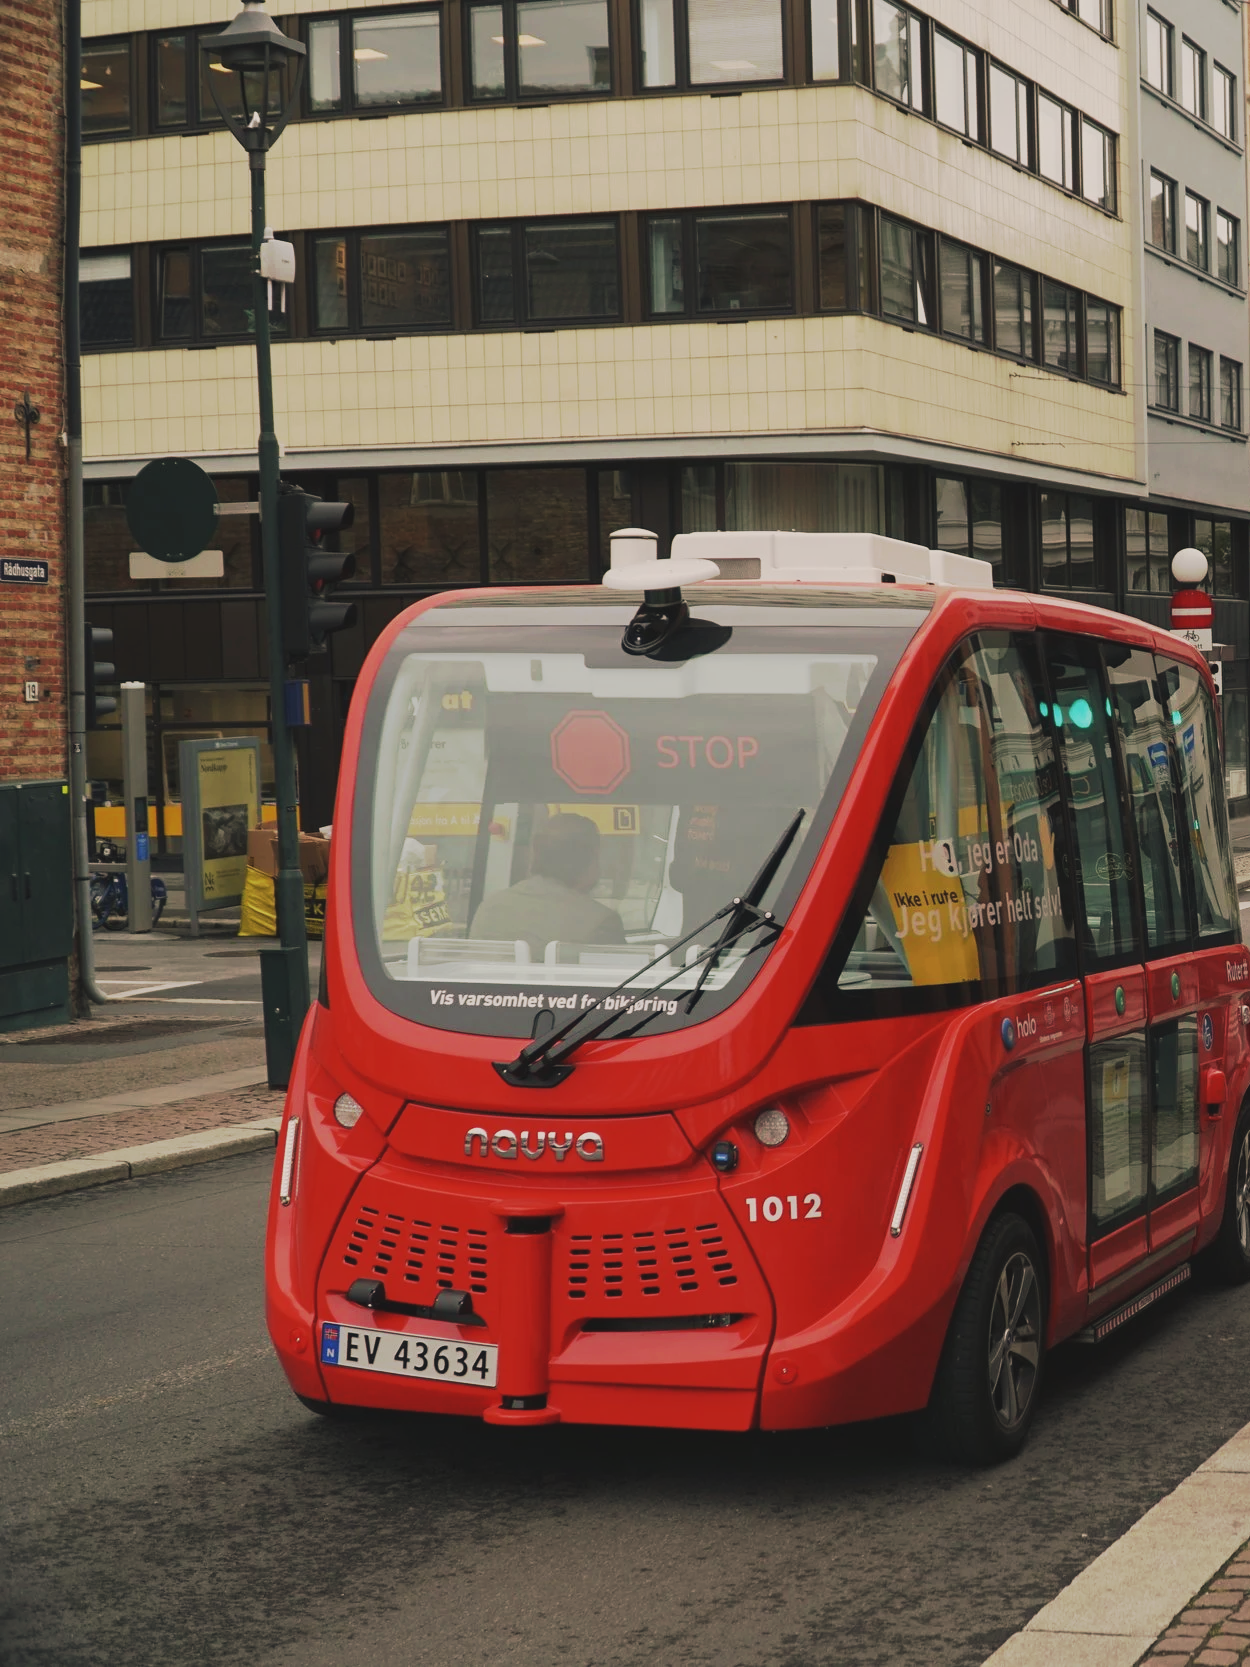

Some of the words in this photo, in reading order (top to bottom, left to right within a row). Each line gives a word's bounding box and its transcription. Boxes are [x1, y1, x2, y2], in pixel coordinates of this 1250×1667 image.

[3, 562, 45, 580] Rådhusgata
[27, 684, 36, 698] 19
[656, 735, 760, 769] STOP
[966, 836, 993, 874] jeg
[995, 839, 1010, 865] er
[1013, 832, 1038, 863] Oda
[894, 893, 922, 908] Ikke
[930, 890, 959, 905] rute
[895, 904, 942, 942] Jeg
[949, 900, 1004, 938] kjører
[1005, 891, 1033, 924] helt
[1034, 886, 1064, 920] selv!
[430, 989, 454, 1006] Vis
[458, 992, 544, 1009] varsomhet
[548, 994, 577, 1009] ved
[1016, 1013, 1037, 1039] holo
[745, 1193, 822, 1222] 1012
[326, 1348, 335, 1358] N
[346, 1332, 381, 1365] EV
[394, 1340, 489, 1379] 43634
